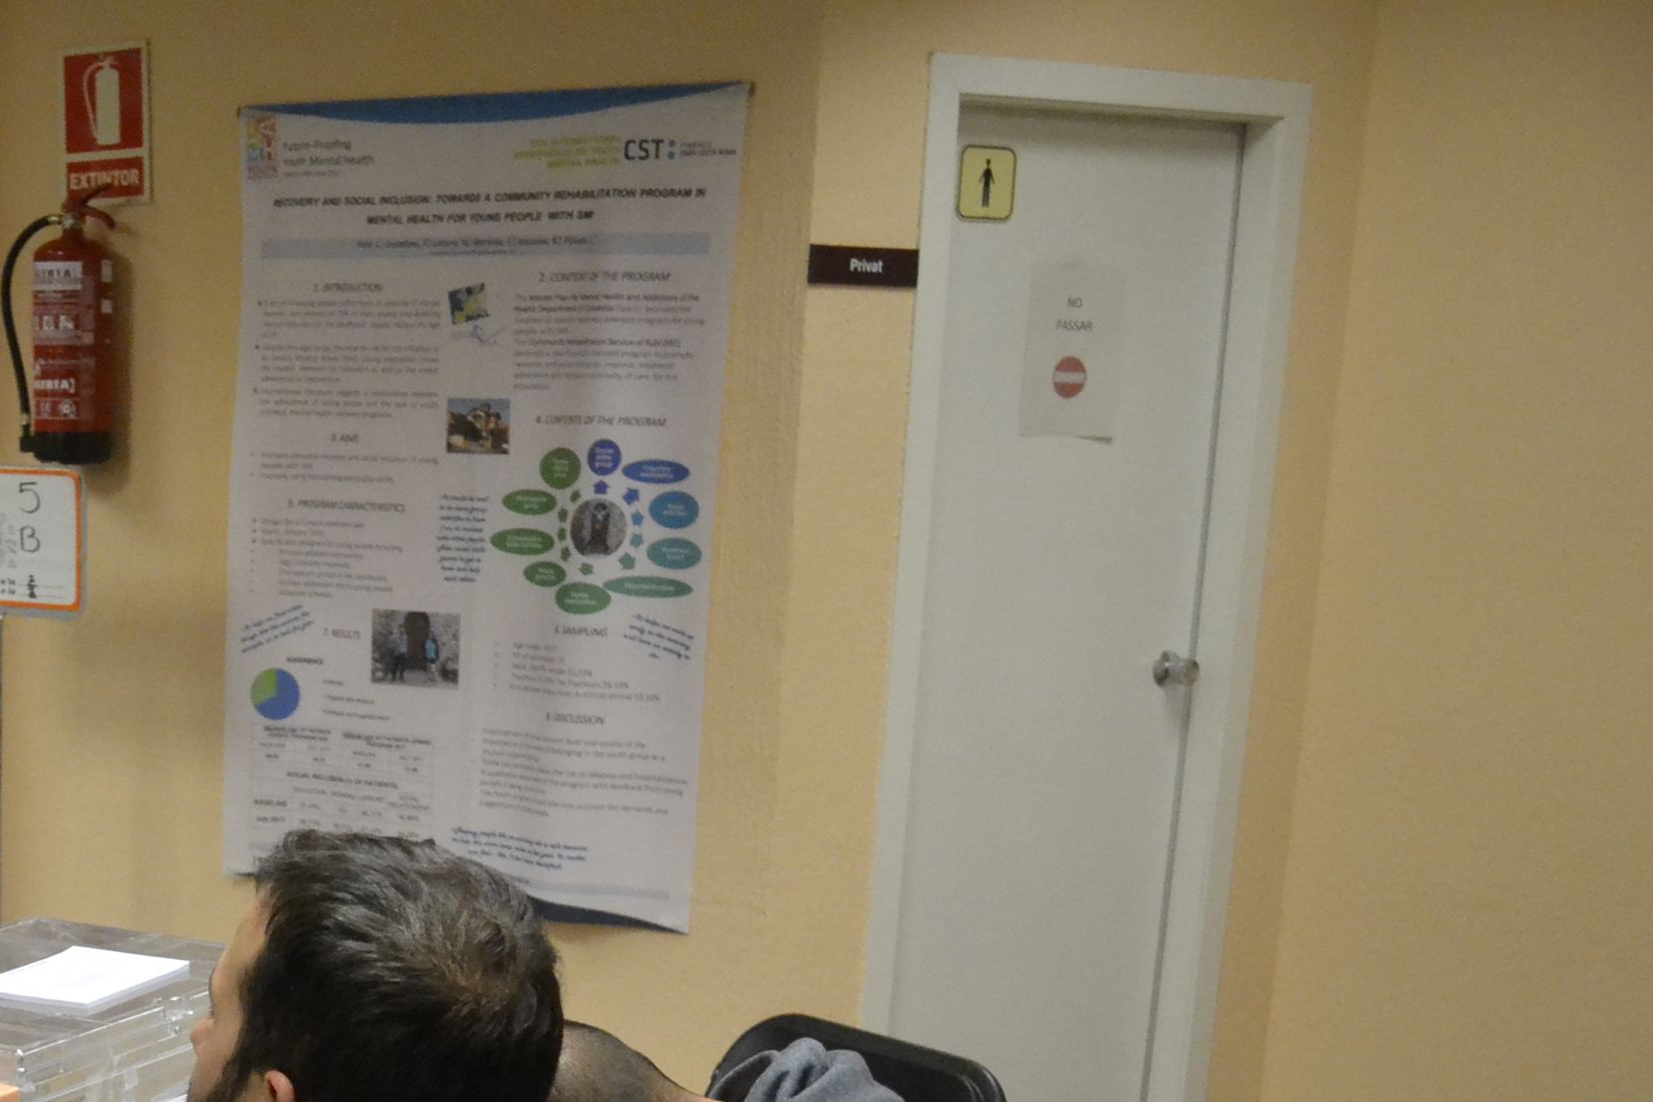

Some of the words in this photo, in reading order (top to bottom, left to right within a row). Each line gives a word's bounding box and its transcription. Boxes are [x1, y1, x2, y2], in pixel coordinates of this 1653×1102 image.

[309, 156, 341, 166] Mental
[344, 154, 375, 166] Health
[69, 168, 141, 190] EXTINTOR
[273, 197, 321, 208] RECOVERY
[322, 196, 341, 206] AND
[344, 196, 377, 206] SOCIAL
[436, 193, 481, 204] TOWARDS
[483, 193, 492, 202] A
[495, 190, 551, 202] COMMUNITY
[553, 188, 637, 200] REHABILITATION
[639, 187, 693, 199] PROGRAM
[695, 187, 708, 198] IN
[366, 214, 403, 225] MENTAL
[406, 213, 445, 224] HEALTH
[446, 212, 466, 223] FOR
[470, 212, 501, 223] YOUNG
[504, 211, 543, 222] PEOPLE
[547, 210, 574, 221] WITH
[849, 257, 883, 274] Privat
[621, 271, 671, 282] PROGRAM
[1067, 296, 1083, 309] NO
[1055, 319, 1093, 332] PASSAR
[618, 415, 667, 427] PROGRAM
[19, 481, 41, 514] 5
[20, 525, 41, 553] B
[562, 625, 609, 637] SAMPLING
[554, 713, 605, 726] DISCUSSION
